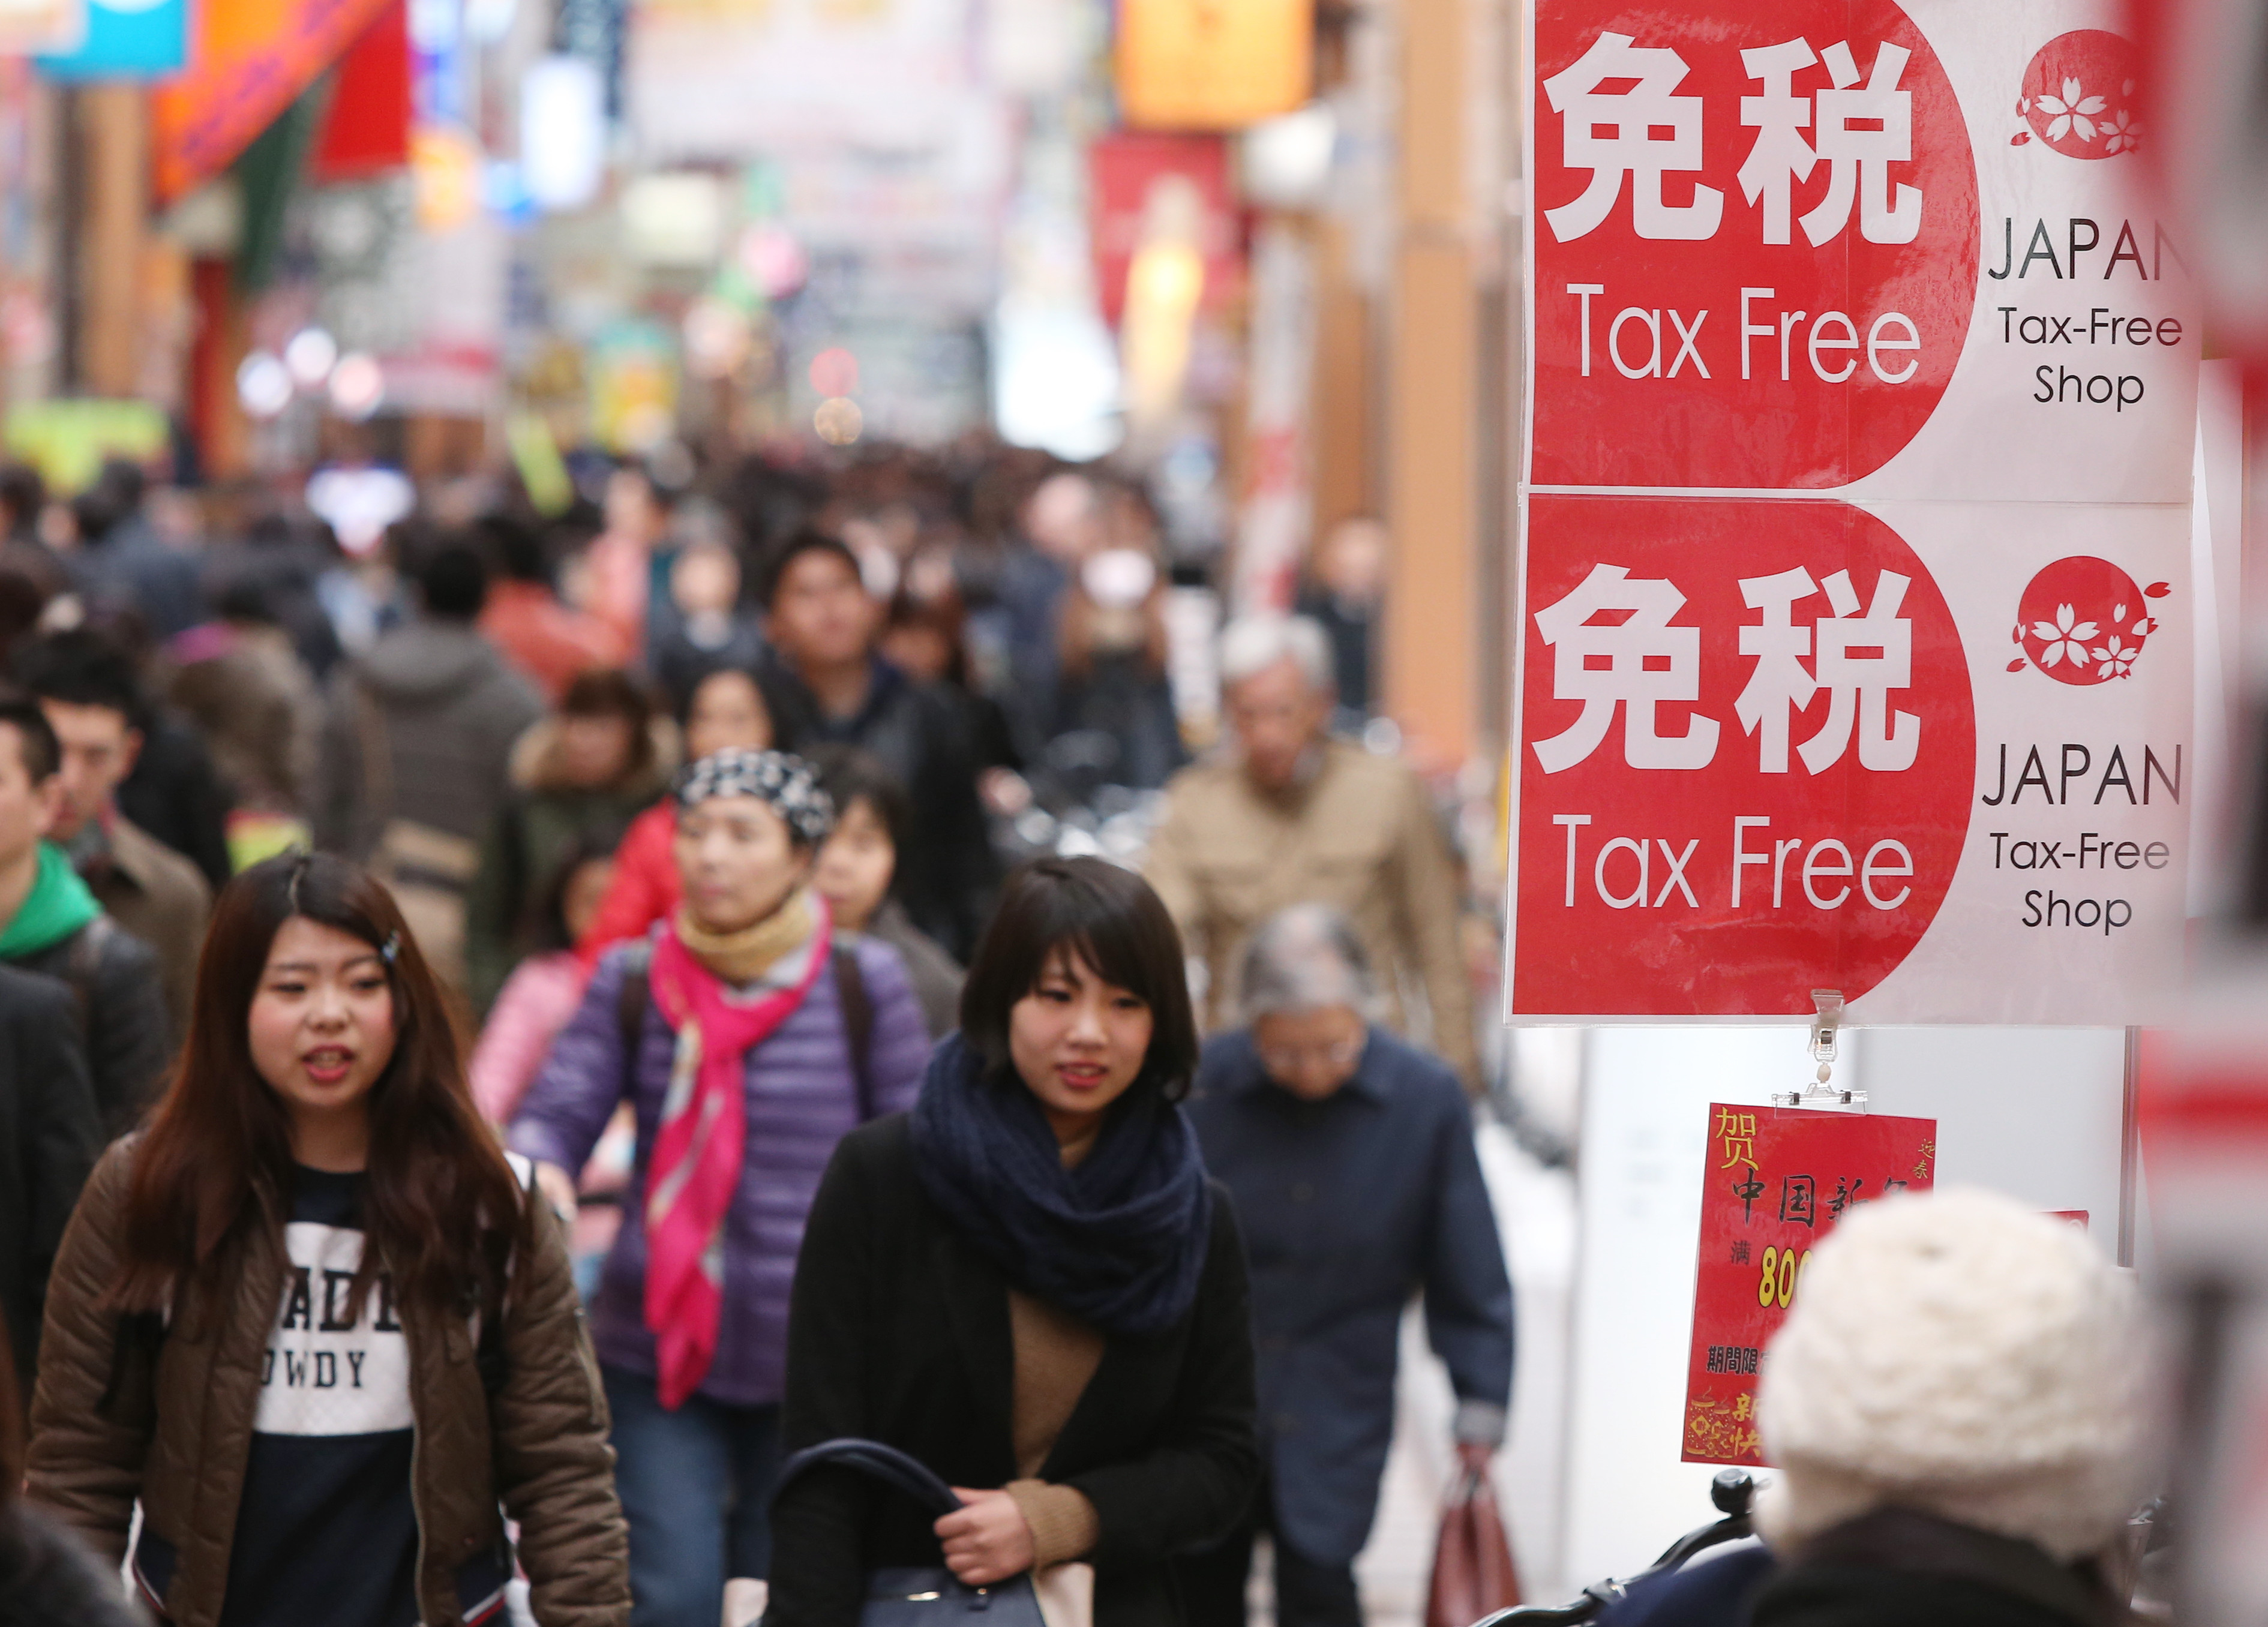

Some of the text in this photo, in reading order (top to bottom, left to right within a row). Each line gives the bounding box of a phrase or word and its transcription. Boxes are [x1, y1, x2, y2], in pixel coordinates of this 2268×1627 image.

[1543, 31, 1922, 248] 免税
[1988, 217, 2194, 281] JAPAN
[1567, 283, 1920, 385] Tax Free
[1997, 307, 2183, 346] Tax-Free
[2033, 365, 2144, 413] Shop
[1531, 563, 1922, 776] 免税
[1982, 743, 2182, 806] JAPAN
[1552, 814, 1914, 910] Tax Free
[1990, 833, 2170, 869] Tax-Free
[2022, 890, 2132, 936] Shop
[1715, 1106, 1759, 1170] 贺
[1730, 1239, 1752, 1266] 满
